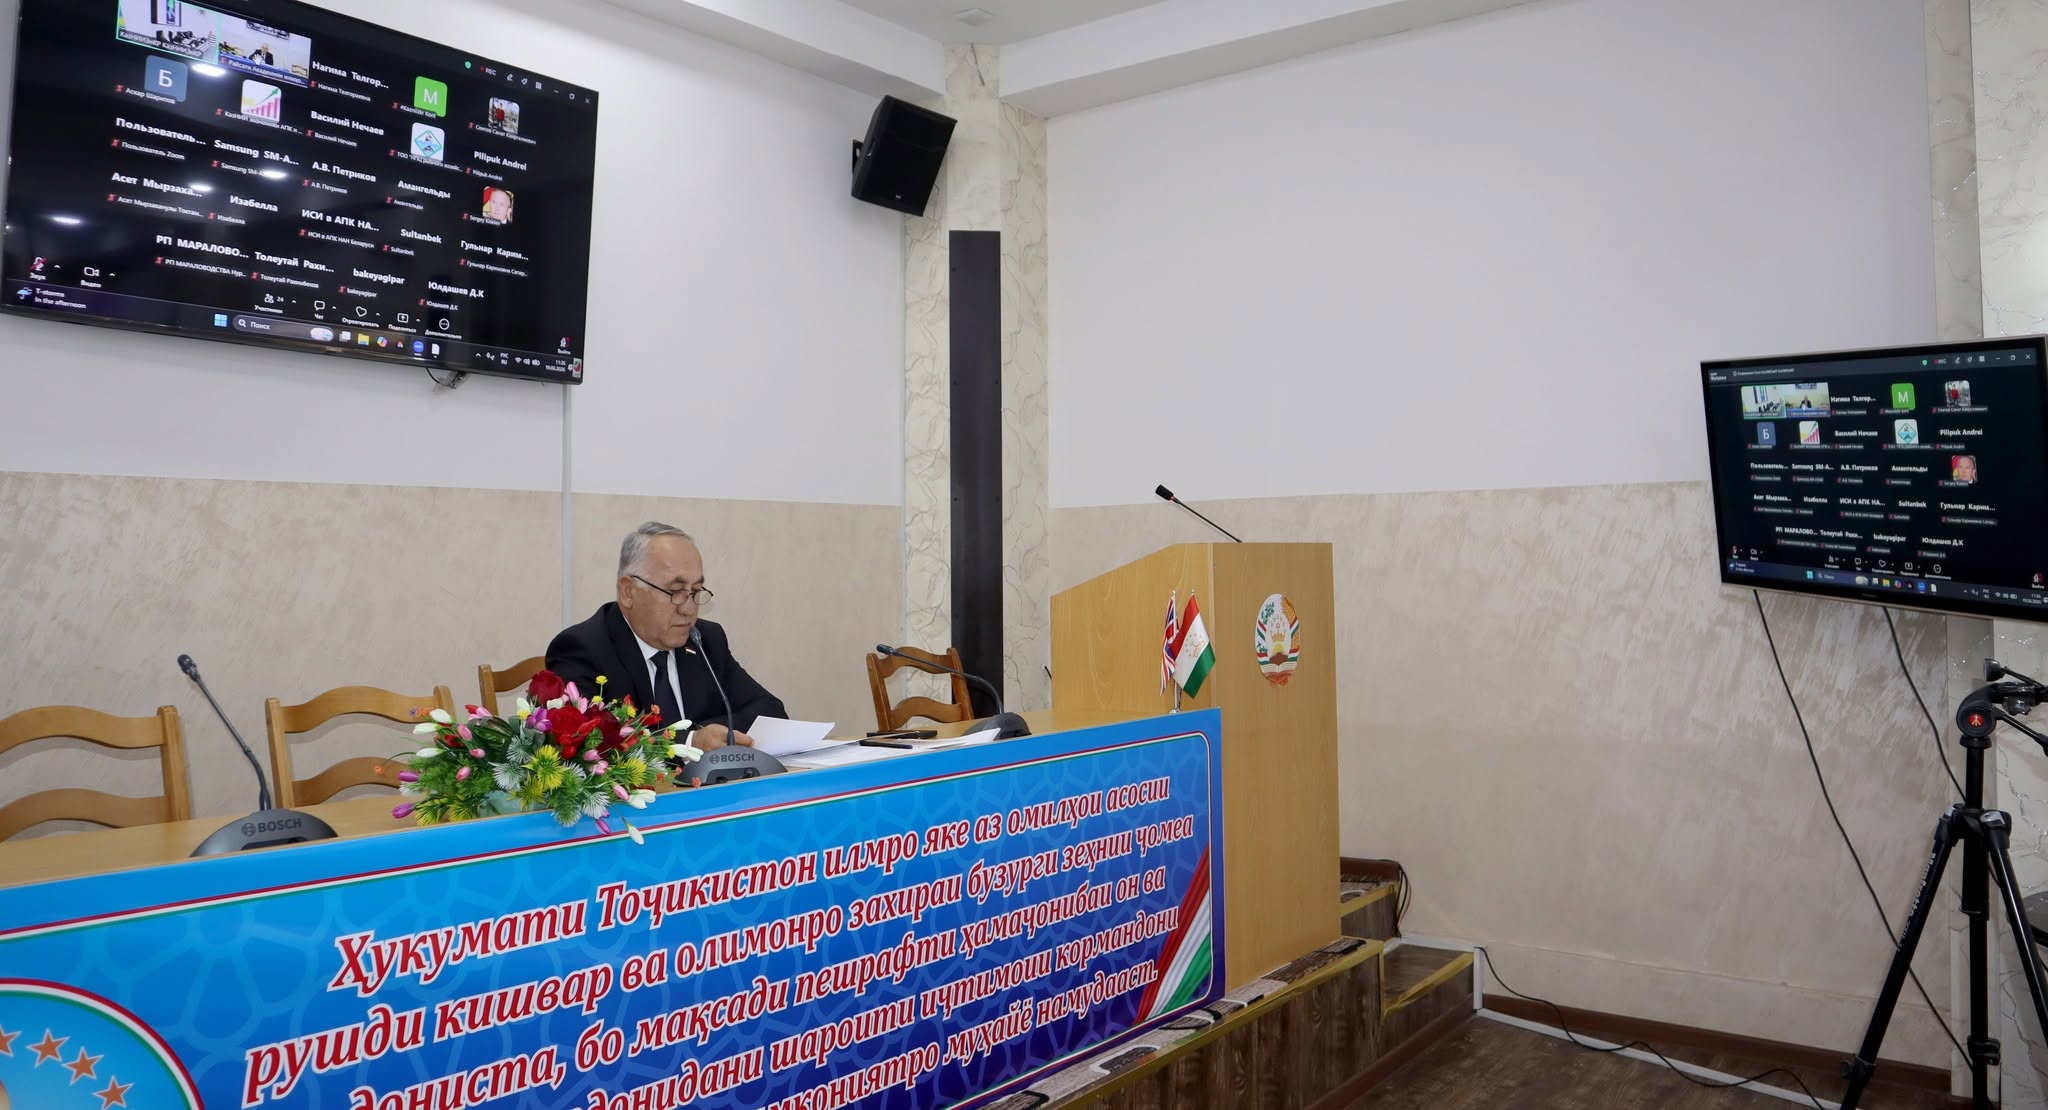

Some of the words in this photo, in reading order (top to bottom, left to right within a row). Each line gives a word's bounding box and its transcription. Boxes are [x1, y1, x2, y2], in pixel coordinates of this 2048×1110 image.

[158, 69, 173, 87] Б
[312, 61, 347, 77] Нагима
[423, 88, 438, 105] M
[116, 117, 206, 146] Пользователь...
[311, 110, 350, 128] Василий
[352, 121, 384, 136] Нечаев
[214, 139, 260, 158] Samsung
[264, 150, 299, 166] SM-A...
[474, 150, 501, 165] Pilipuk
[502, 158, 527, 171] Andrei
[312, 161, 331, 172] А.В.
[332, 165, 376, 182] Петриков
[112, 172, 138, 186] Асет
[143, 178, 203, 198] Мырзаха...
[398, 180, 450, 199] Амангельды
[230, 195, 279, 212] Изабелла
[302, 209, 323, 221] ИСИ
[326, 214, 332, 222] в
[334, 215, 355, 227] АПК
[358, 220, 379, 231] НА...
[401, 228, 442, 243] Sultanbek
[156, 235, 172, 246] РП
[177, 238, 249, 259] МАРАЛОВО...
[461, 240, 493, 254] Гульнар
[497, 247, 528, 260] Карим...
[255, 251, 299, 267] Толеутай
[303, 260, 334, 273] Рахи...
[353, 268, 405, 285] bakeyagipar
[428, 281, 468, 296] Юлдашев
[250, 321, 270, 331] Поиск
[1898, 391, 1909, 403] M
[1762, 428, 1770, 440] Б
[1939, 429, 1961, 437] Pilipuk
[1962, 428, 1983, 436] Andrei
[721, 753, 755, 763] BOSCH
[257, 818, 302, 833] BOSCH
[327, 897, 589, 997] Ҳукумати
[595, 853, 817, 930] Тоҷикистон
[823, 825, 918, 880] илмро
[921, 817, 969, 857] яке
[973, 811, 1002, 842] аз
[1007, 786, 1103, 838] омилҳои
[1105, 776, 1170, 814] асосии
[241, 1002, 430, 1109] рушди
[433, 962, 615, 1043] кишвар
[620, 947, 667, 996] ва
[675, 903, 842, 976] олимонро
[848, 873, 963, 931] захираи
[966, 848, 1059, 904] бузурги
[1061, 829, 1132, 873] зеҳнии
[1135, 814, 1194, 855] ҷомеа
[575, 1019, 625, 1073] бо
[628, 974, 789, 1057] мақсади
[795, 929, 955, 1006] пешрафти
[959, 875, 1113, 952] ҳамаҷонибаи
[1115, 872, 1141, 901] он
[1142, 865, 1166, 892] ва
[768, 993, 916, 1073] шароити
[920, 947, 1052, 1023] иҷтимоии
[1055, 905, 1179, 972] кормандони
[943, 1001, 1034, 1066] муҳайё
[1035, 959, 1159, 1030] намудааст.
